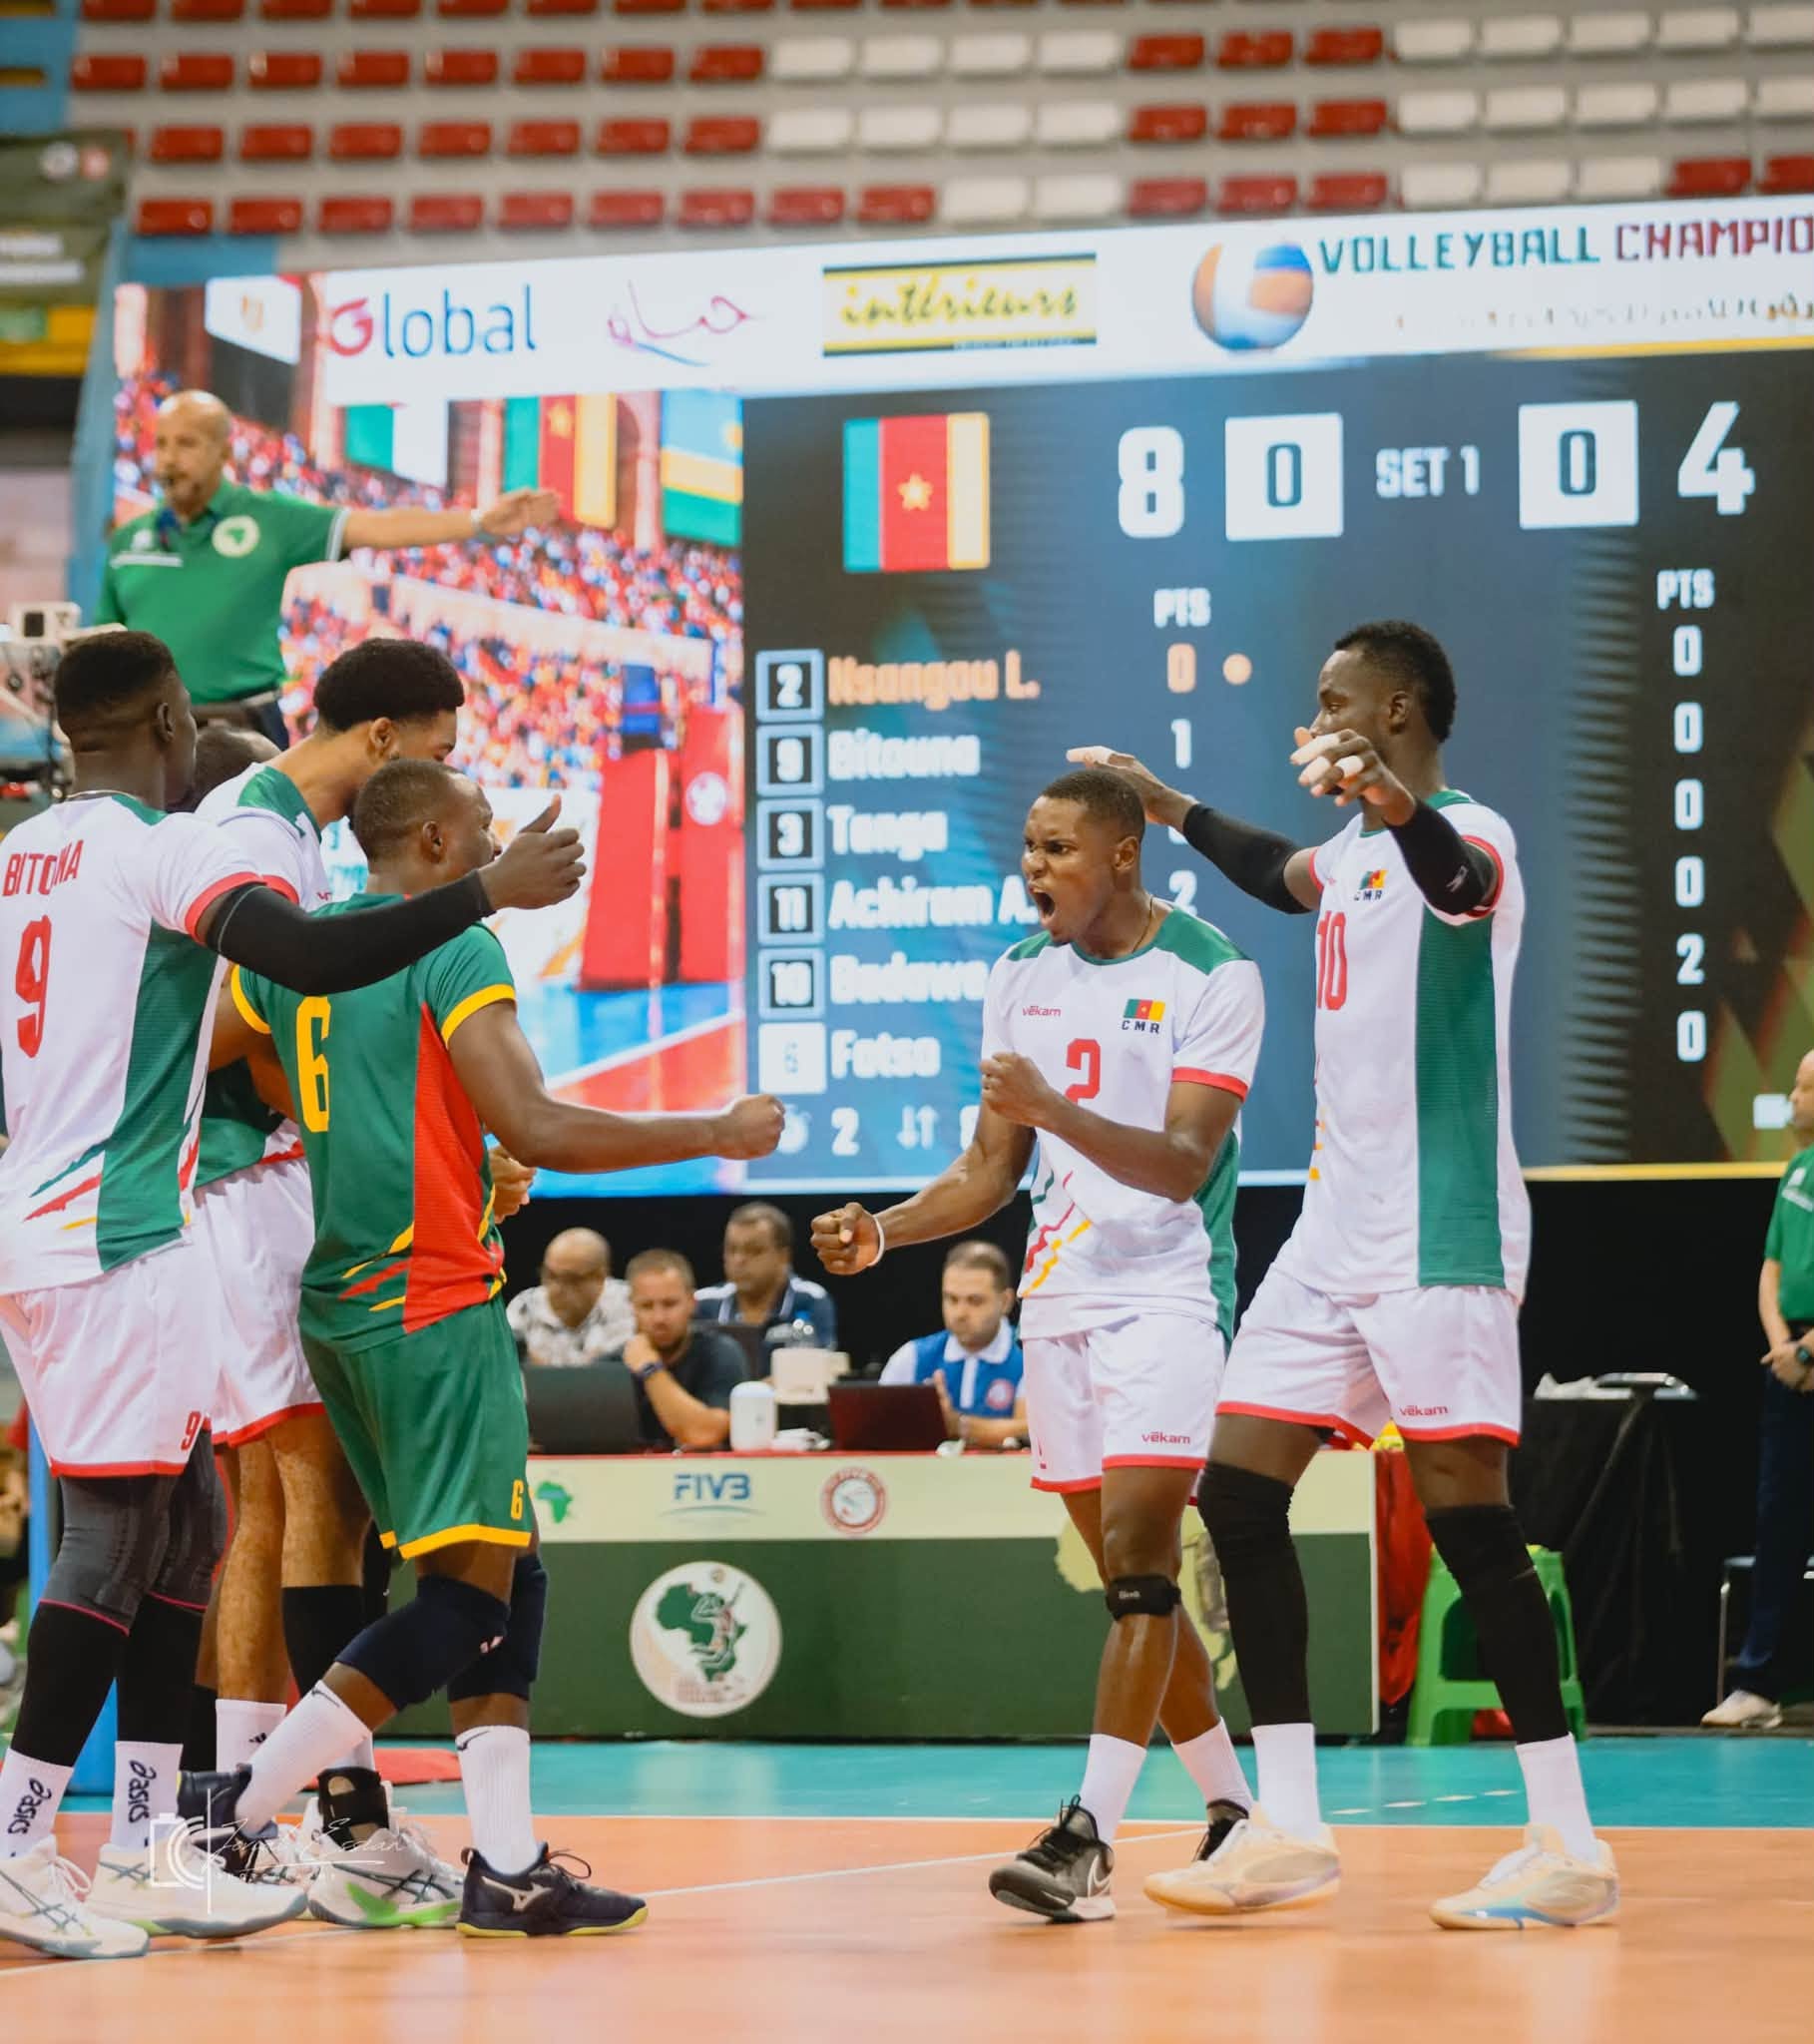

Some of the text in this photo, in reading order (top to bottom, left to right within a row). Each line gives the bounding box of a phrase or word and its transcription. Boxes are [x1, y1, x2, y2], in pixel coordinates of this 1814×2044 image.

[1320, 226, 1599, 273] VOLLEYBALL
[329, 282, 537, 358] Global
[1118, 401, 1755, 538] 8 0 SET 1 0 4
[1153, 588, 1211, 628] PTS
[1657, 569, 1714, 610] PTS
[776, 663, 803, 708] 2
[1005, 650, 1040, 699] L.
[1167, 644, 1196, 694] 0
[1673, 626, 1702, 676] 0
[1171, 719, 1191, 768] 1
[1674, 703, 1703, 753] 0
[1674, 779, 1704, 830] 0
[777, 812, 804, 856] 3
[773, 886, 807, 931] 11
[1168, 870, 1197, 917] 2
[1675, 856, 1704, 907] 0
[771, 961, 811, 1007] 10
[1317, 910, 1347, 1010] 10
[1676, 934, 1704, 984] 2
[15, 913, 52, 1058] 9
[1122, 1020, 1159, 1034] CMR
[1677, 1011, 1706, 1062] 0
[296, 995, 331, 1133] 6
[1065, 1038, 1101, 1106] 2
[831, 1107, 859, 1156] 2
[181, 1410, 202, 1451] 9
[511, 1479, 524, 1520] 6
[7, 1778, 53, 1834] asics
[128, 1760, 157, 1823] asics
